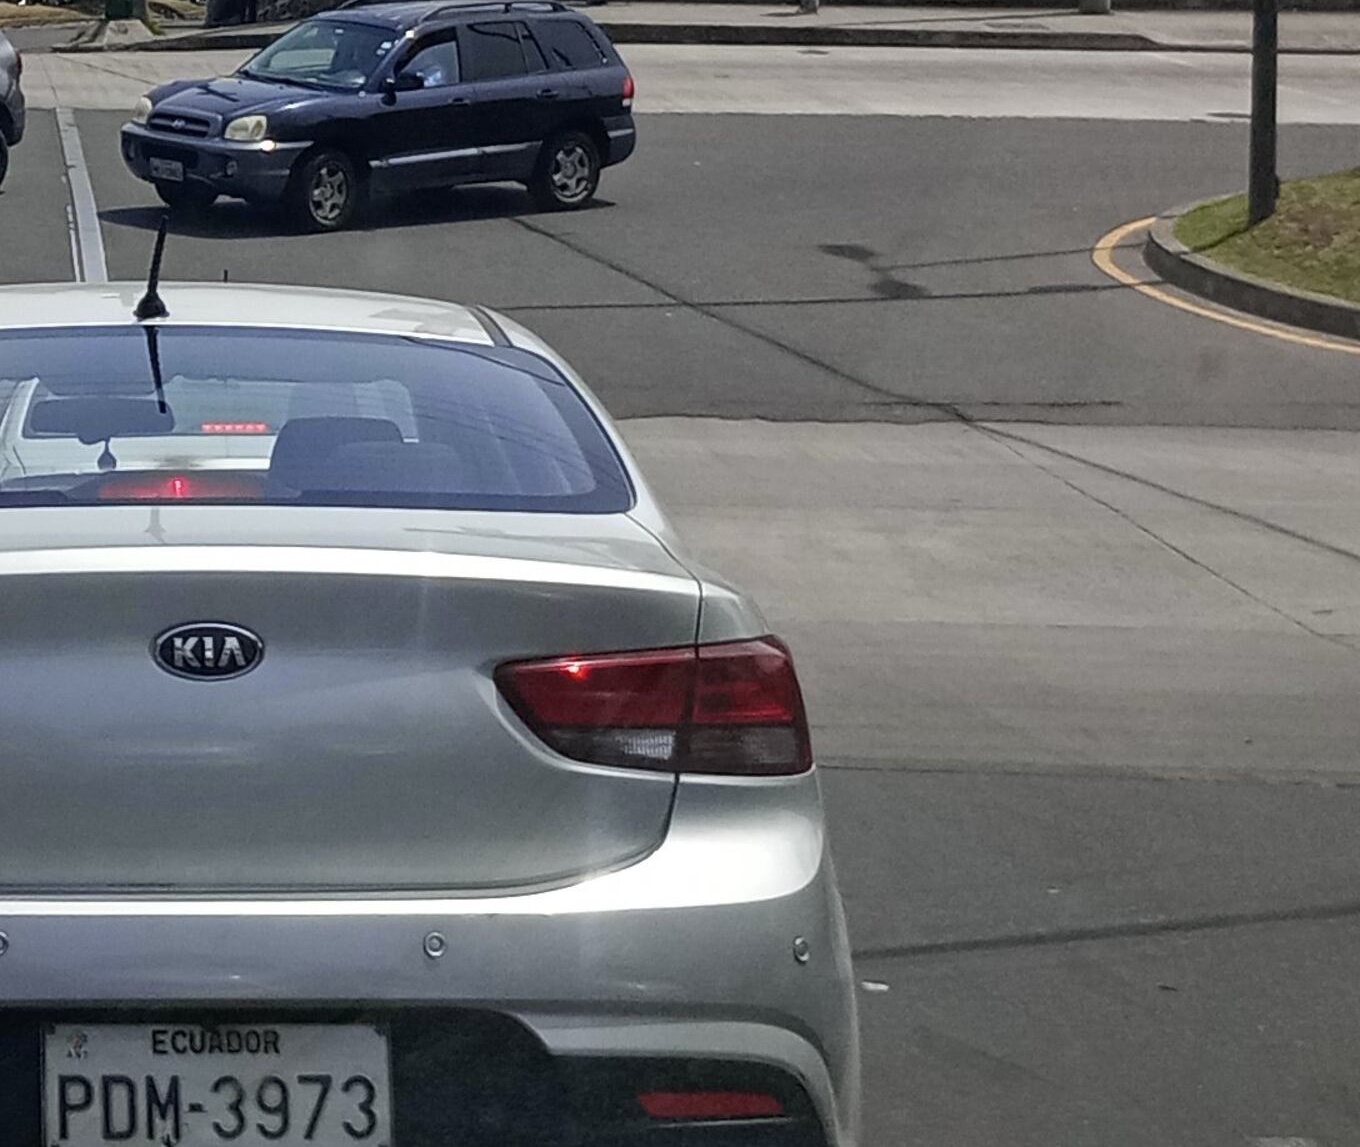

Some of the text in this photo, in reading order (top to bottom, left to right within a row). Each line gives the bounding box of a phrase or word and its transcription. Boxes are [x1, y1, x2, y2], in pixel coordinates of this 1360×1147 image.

[172, 636, 247, 667] KIA
[151, 1029, 280, 1055] ECUADOR
[57, 1074, 378, 1142] PDM-3973
